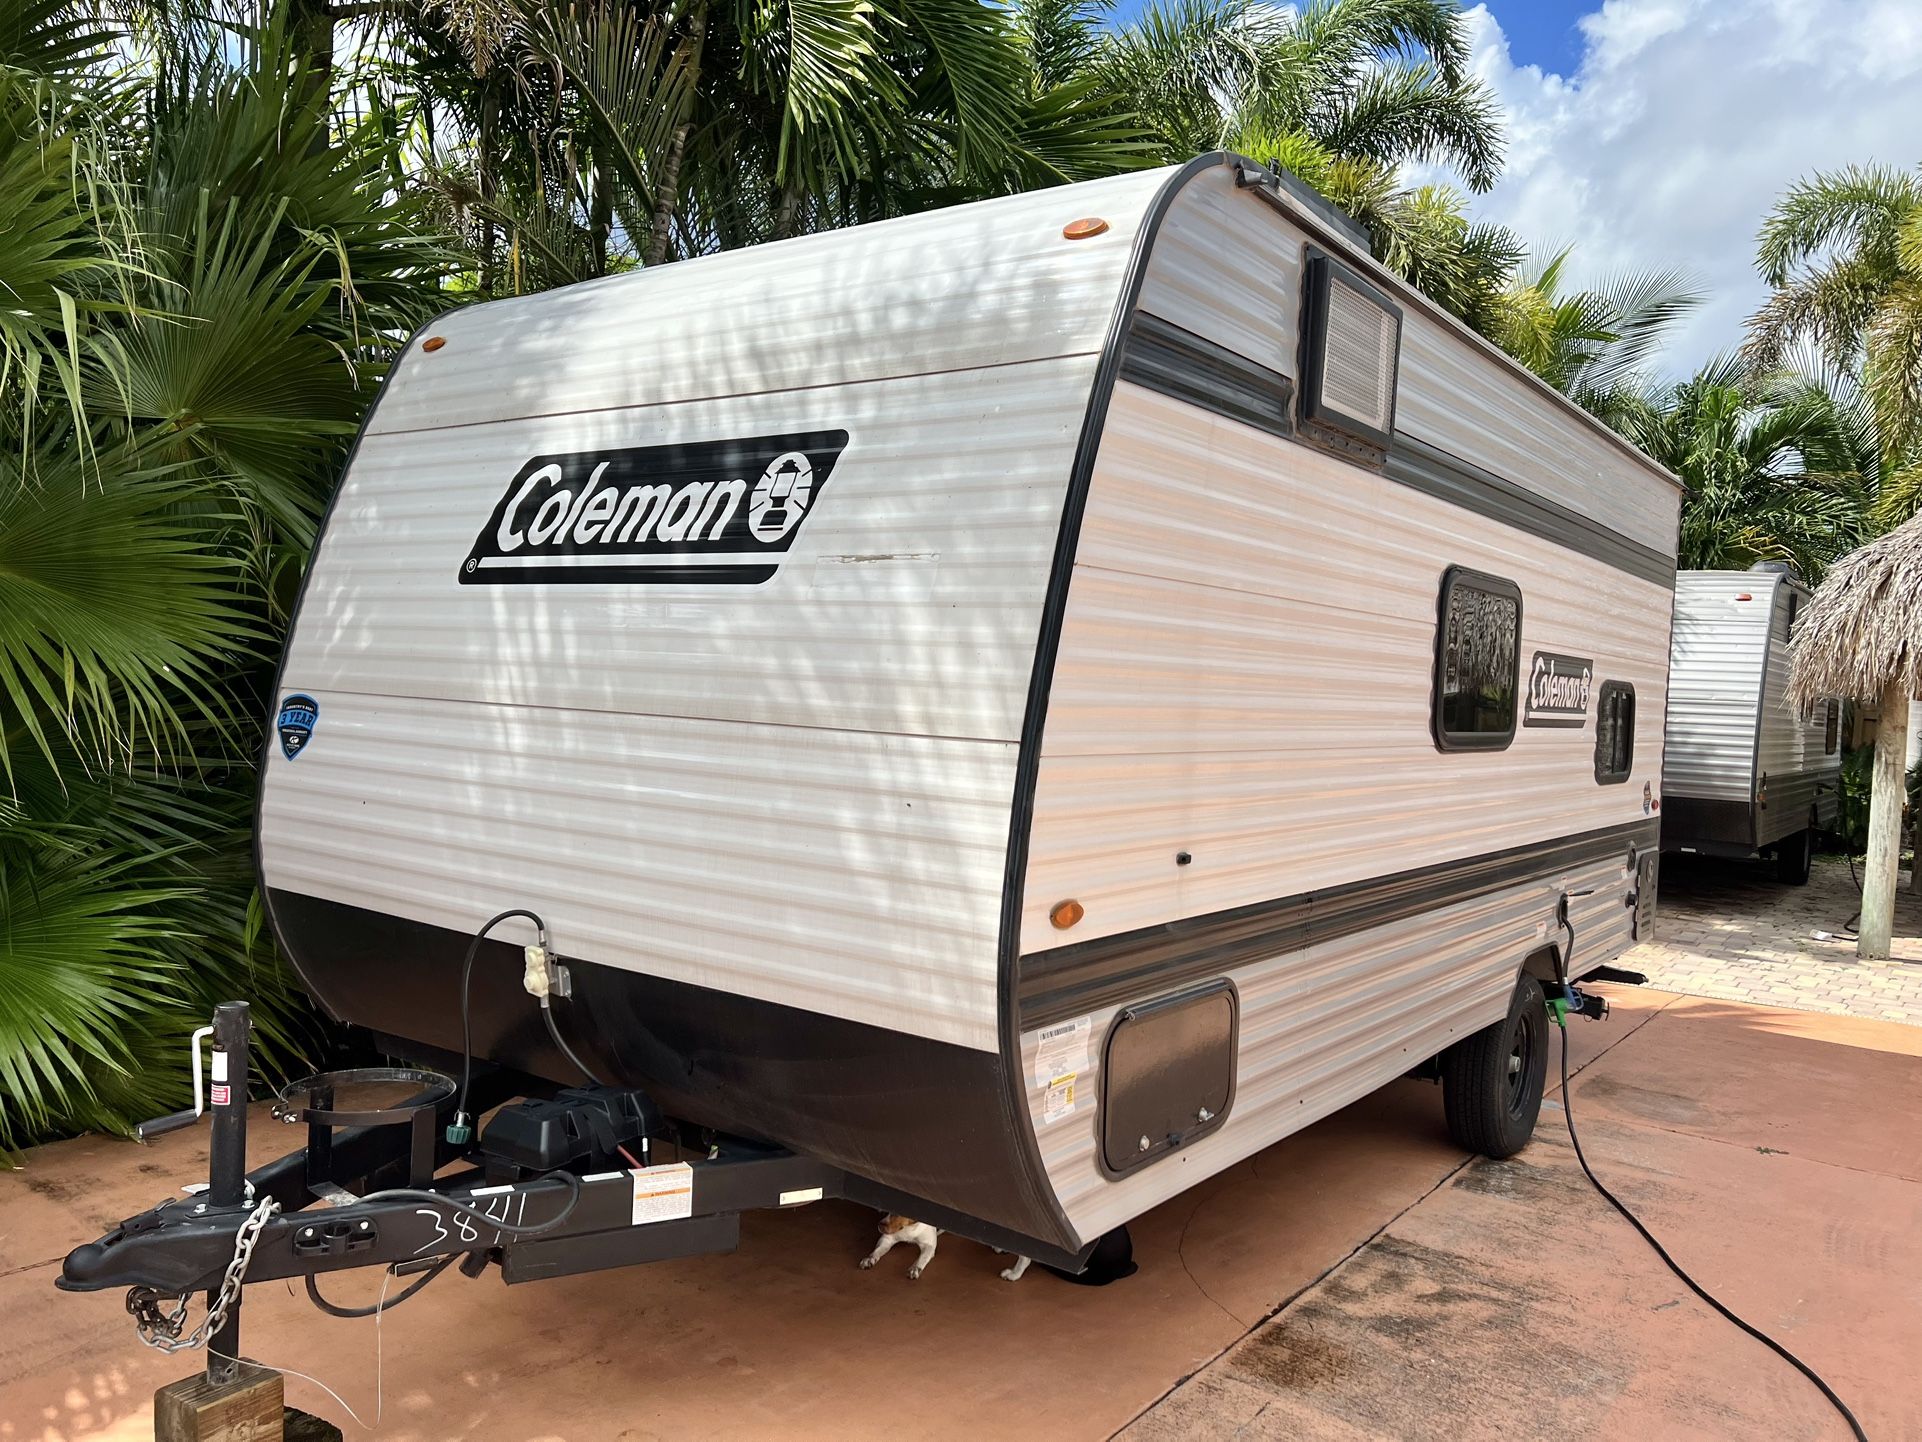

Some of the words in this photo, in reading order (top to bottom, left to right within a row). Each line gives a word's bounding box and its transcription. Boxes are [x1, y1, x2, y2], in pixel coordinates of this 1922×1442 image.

[496, 461, 748, 552] Coleman
[1530, 656, 1580, 709] Coleman
[280, 713, 288, 725] 3
[289, 711, 314, 727] YEAR
